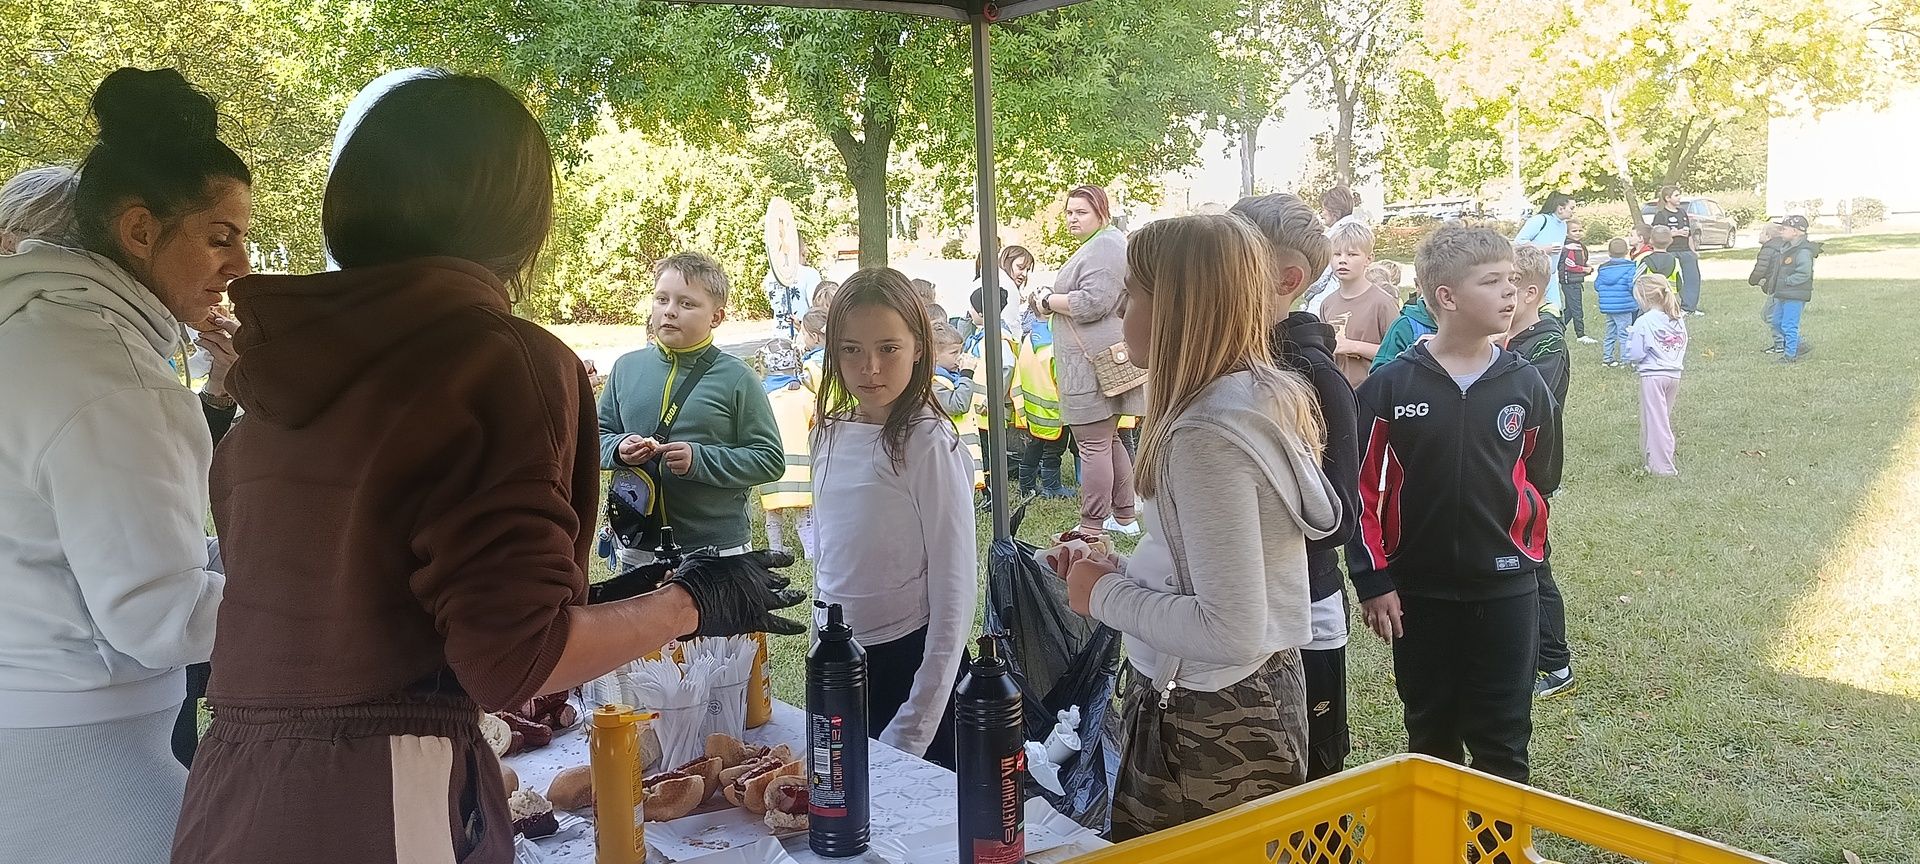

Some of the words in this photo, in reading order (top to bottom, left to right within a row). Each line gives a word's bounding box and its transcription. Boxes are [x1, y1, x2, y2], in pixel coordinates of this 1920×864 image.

[664, 402, 678, 427] XBOX
[1394, 402, 1430, 420] PSG
[1503, 406, 1525, 417] PARIS
[832, 763, 843, 791] KETCHUP
[1001, 779, 1016, 828] KETCHUP
[1004, 827, 1015, 843] 07
